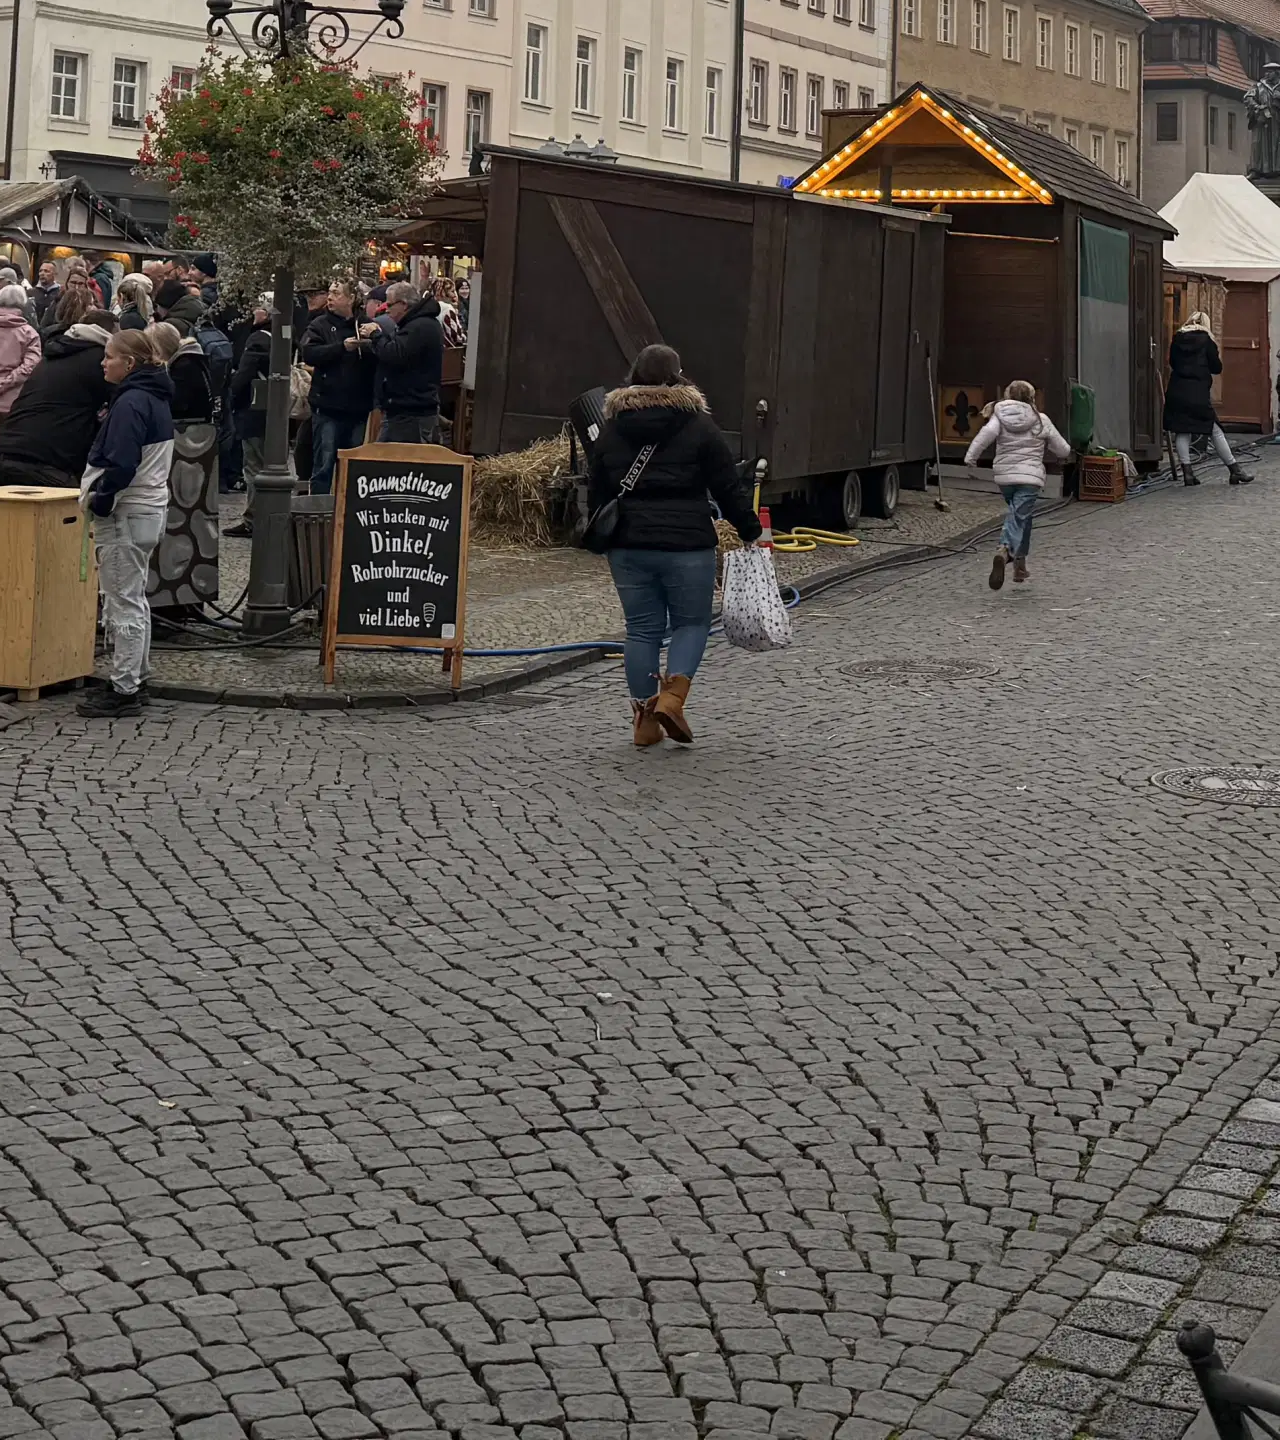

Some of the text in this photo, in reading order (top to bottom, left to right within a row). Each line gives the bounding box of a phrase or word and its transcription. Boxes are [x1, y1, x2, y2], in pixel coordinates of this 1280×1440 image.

[357, 471, 453, 500] Baumstriezel
[356, 508, 450, 532] Wir backen mit
[370, 529, 434, 560] Dinkel,
[351, 560, 449, 587] Rohrohrzucker
[387, 586, 410, 603] und
[359, 608, 420, 628] viel Liebe
